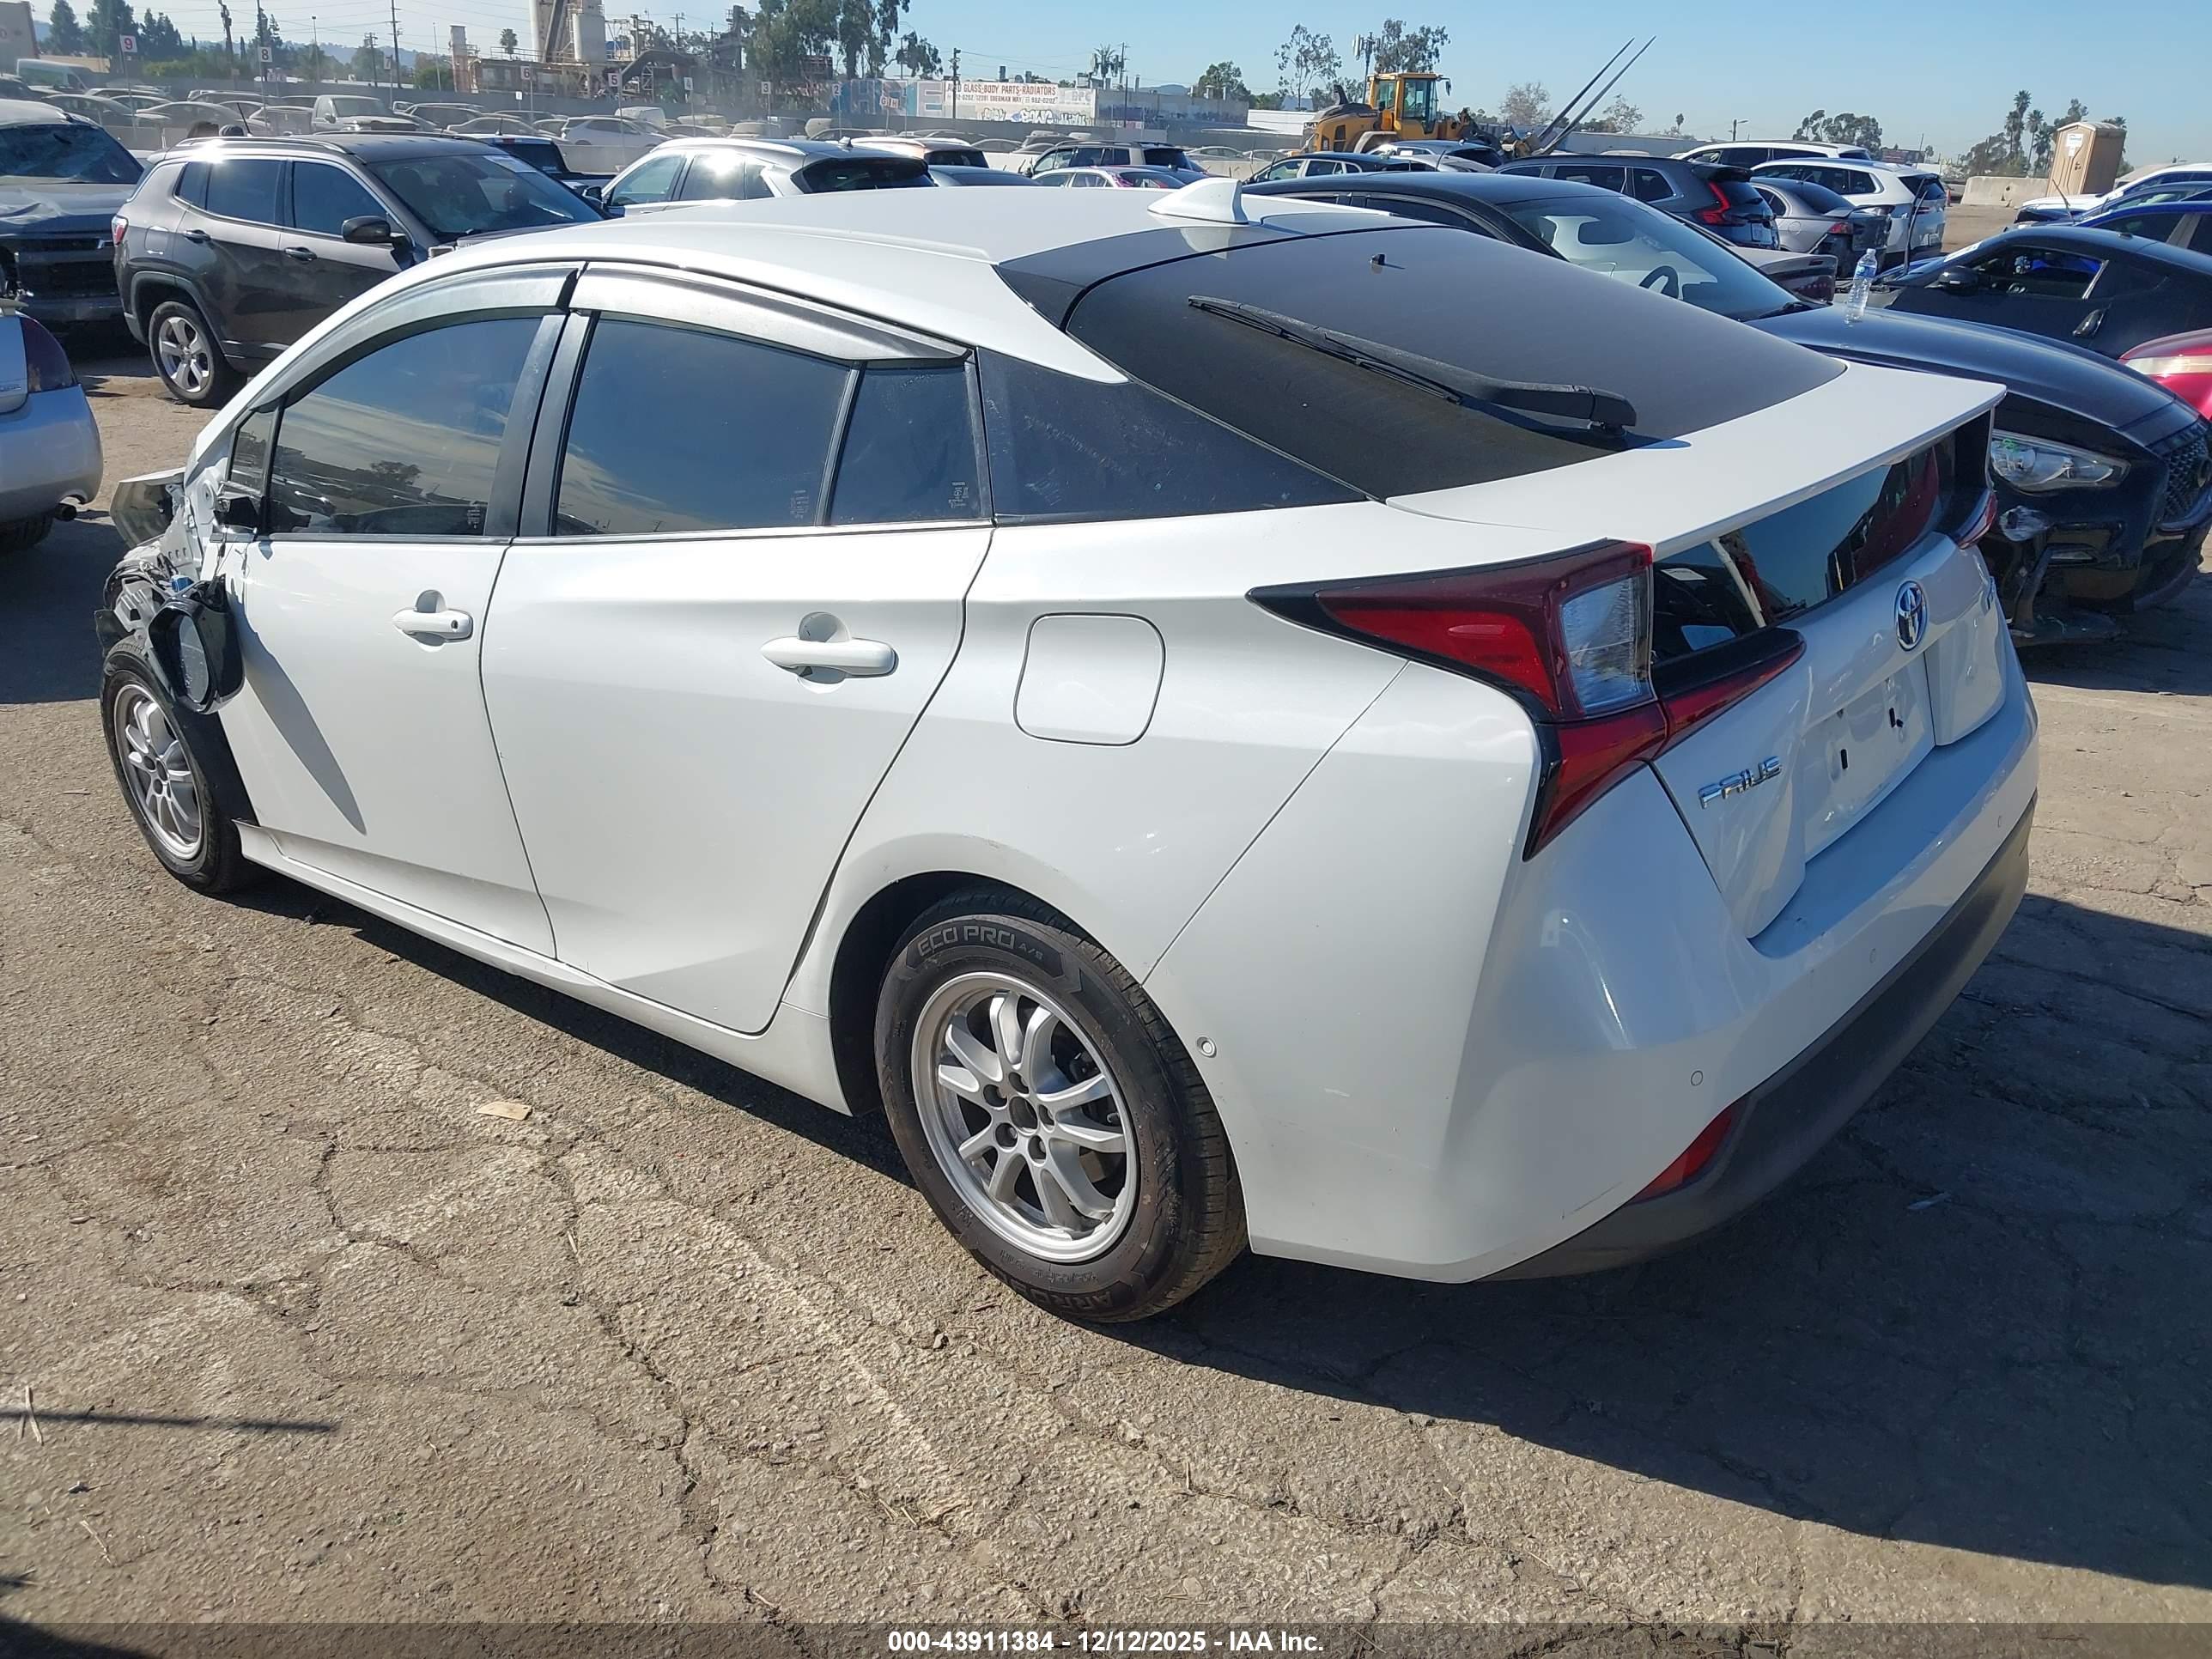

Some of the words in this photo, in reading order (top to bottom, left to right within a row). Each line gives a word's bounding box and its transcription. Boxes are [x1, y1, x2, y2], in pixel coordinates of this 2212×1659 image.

[125, 38, 133, 50] 9
[262, 49, 269, 60] 8
[524, 68, 530, 78] 6
[611, 75, 618, 85] 5
[763, 83, 769, 93] 3
[834, 85, 839, 94] 2
[1698, 756, 1782, 810] PRIUS
[917, 927, 959, 957] ECO
[963, 925, 1016, 950] PRO
[1018, 942, 1044, 960] A/S
